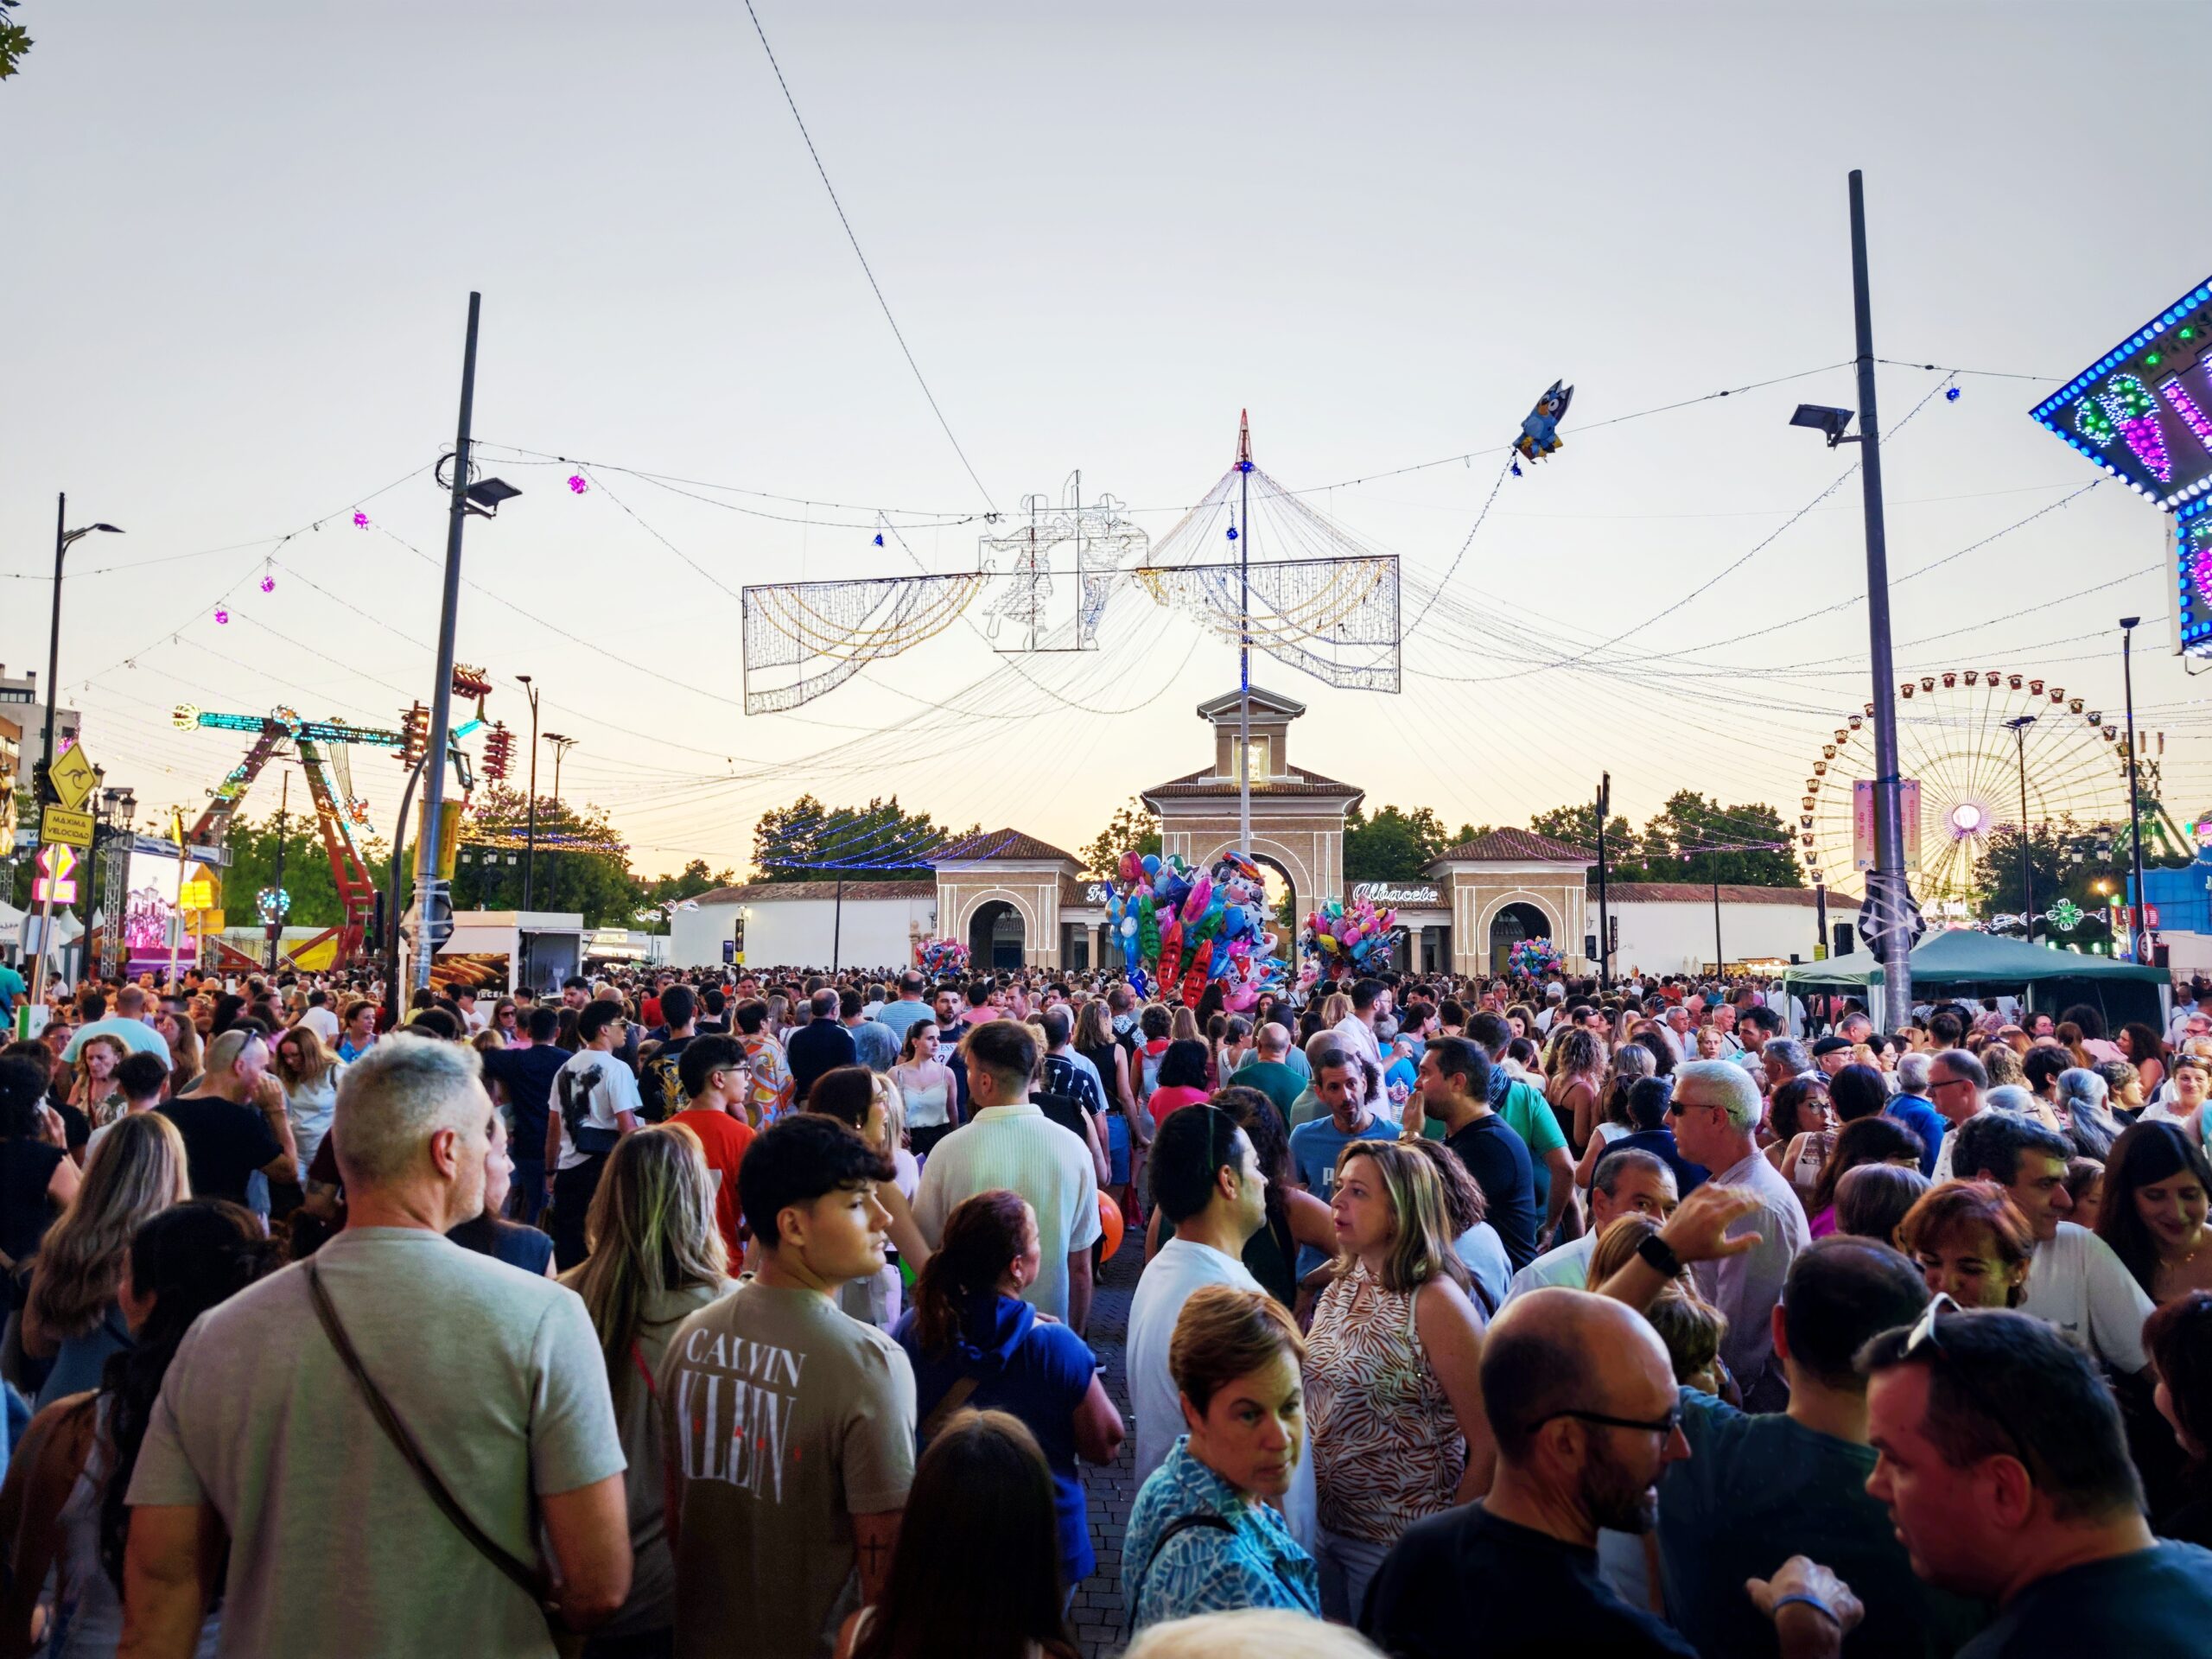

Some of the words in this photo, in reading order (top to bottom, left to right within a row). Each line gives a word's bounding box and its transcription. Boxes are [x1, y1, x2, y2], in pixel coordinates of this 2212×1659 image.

[47, 826, 90, 839] VELOCIDAD
[1352, 883, 1438, 901] Albacete
[686, 1328, 806, 1388] CALVIN
